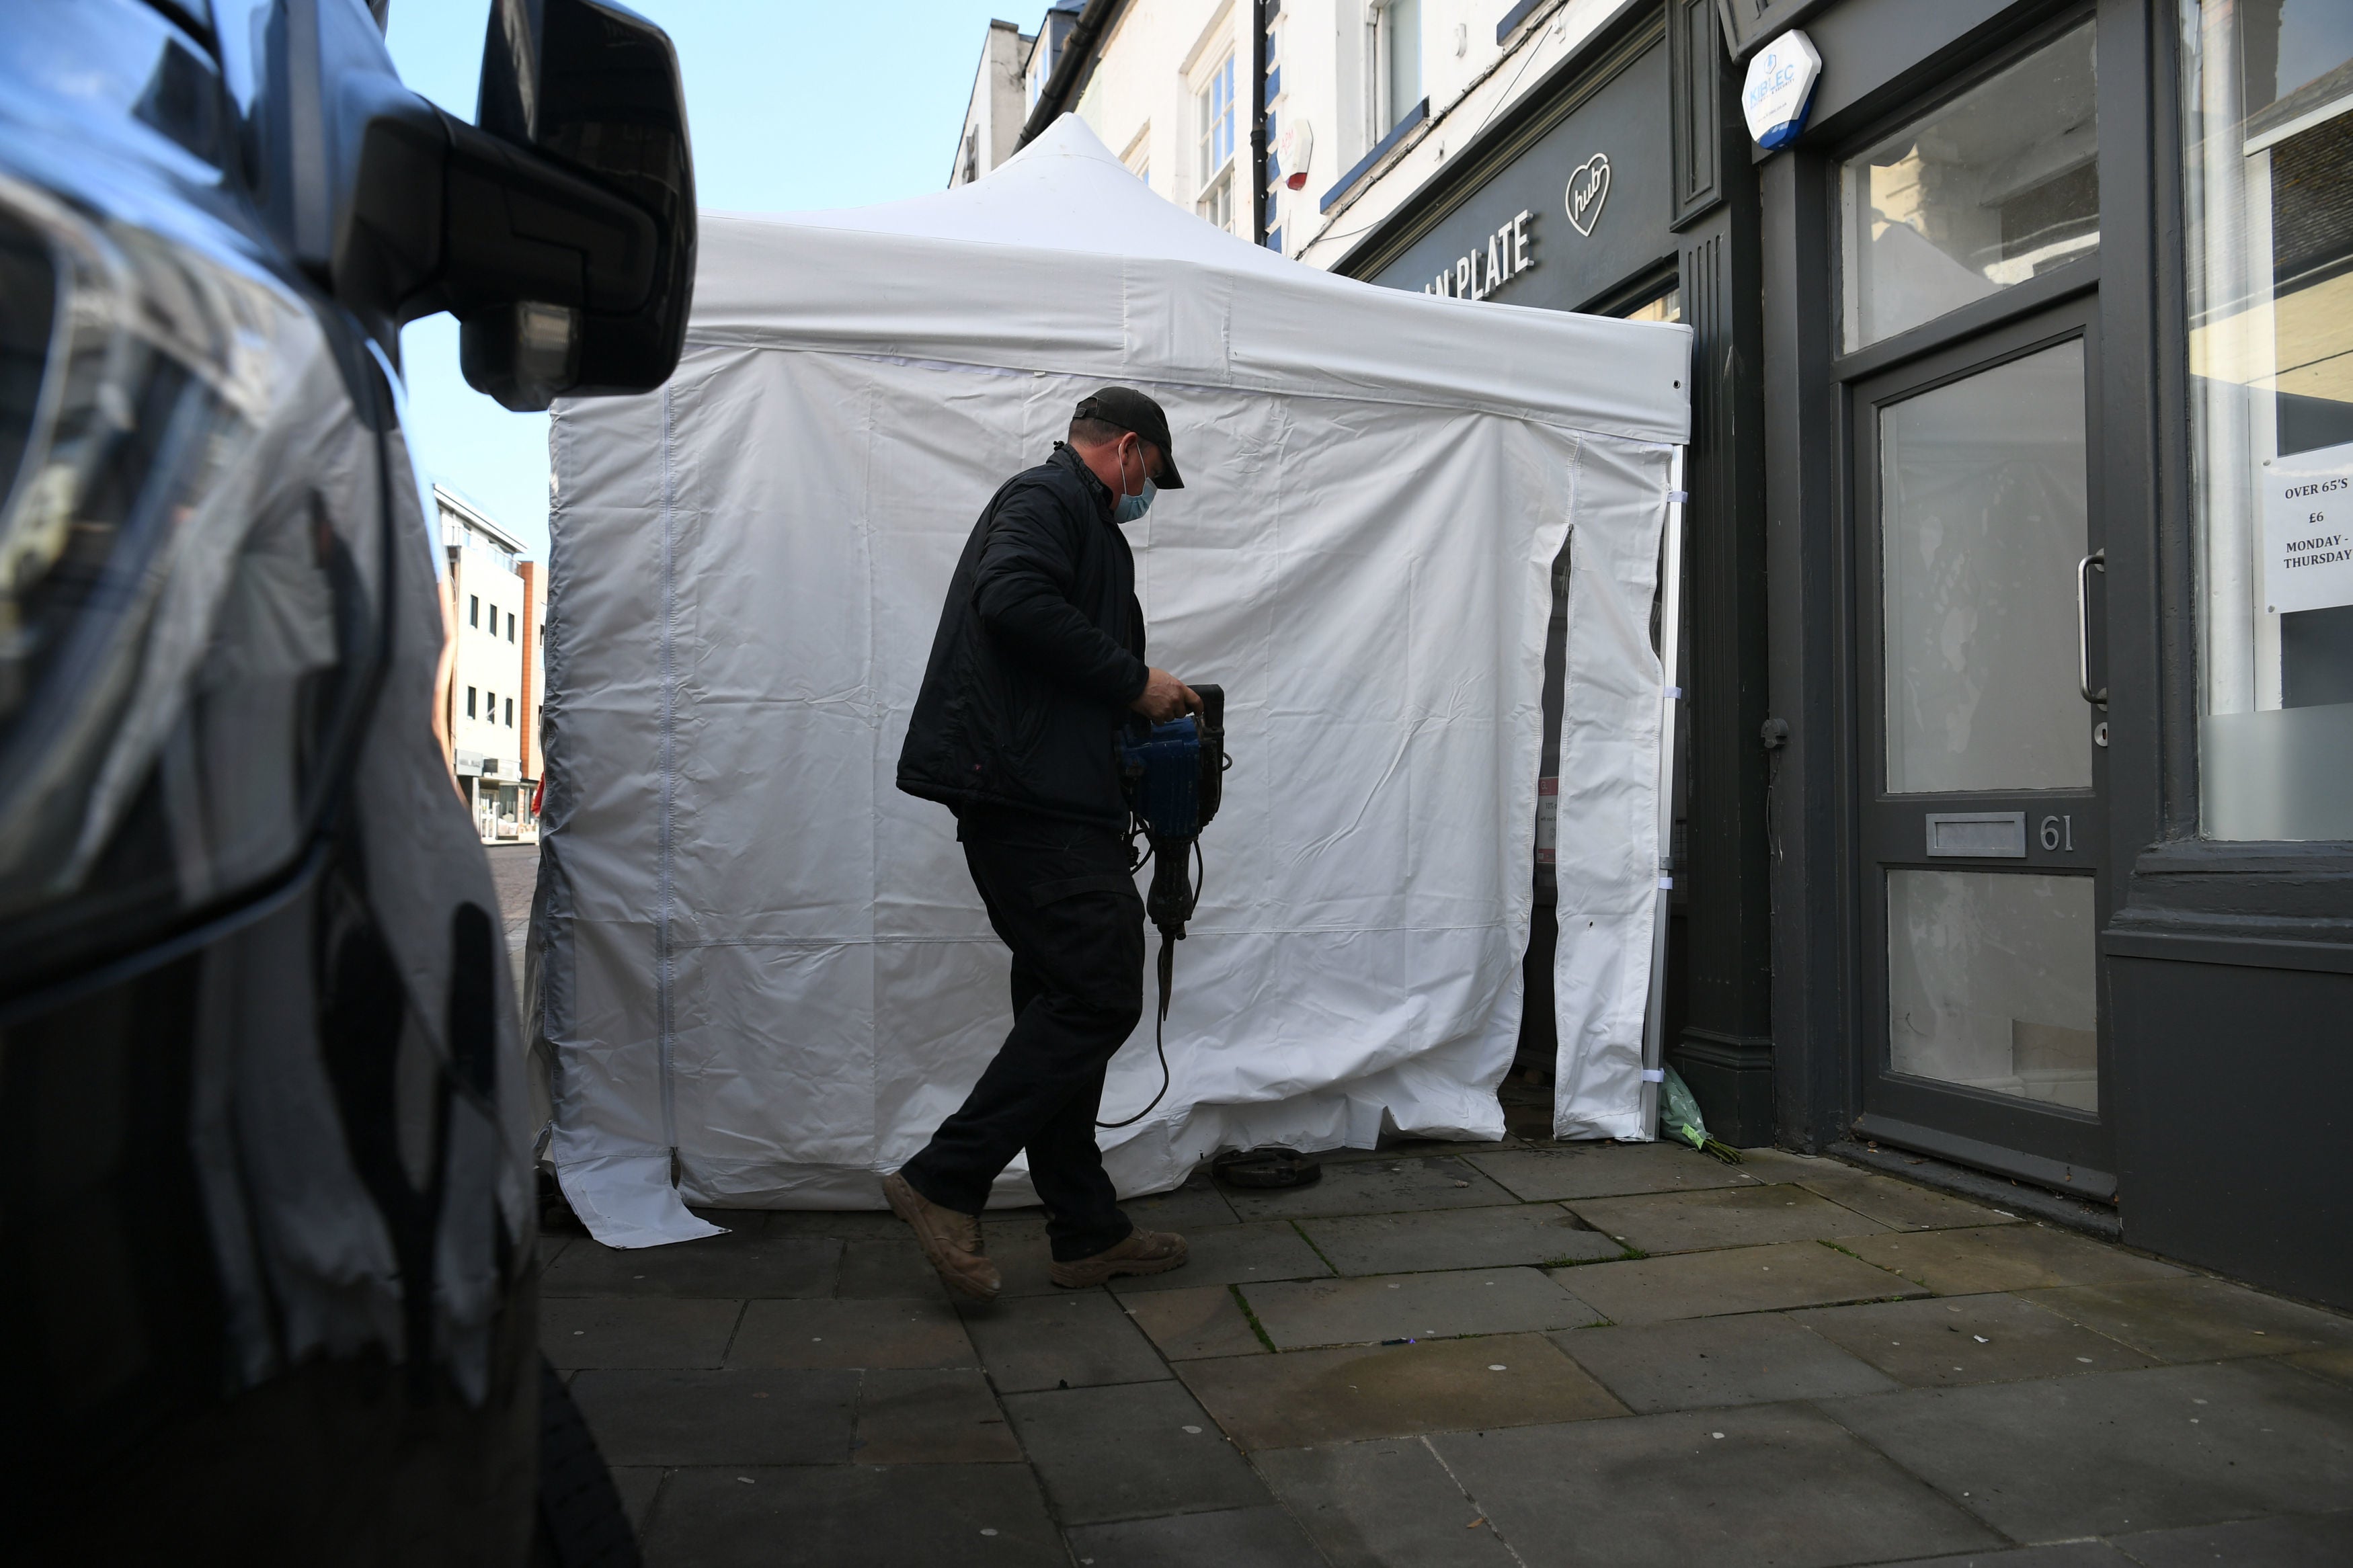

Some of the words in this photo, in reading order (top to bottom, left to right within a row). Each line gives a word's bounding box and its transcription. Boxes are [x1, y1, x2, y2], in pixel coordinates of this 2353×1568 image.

[1574, 167, 1601, 220] hub
[1457, 209, 1529, 300] PLATE
[2285, 484, 2319, 499] OVER
[2309, 511, 2324, 524] £6
[2286, 534, 2342, 552] MONDAY
[2284, 549, 2352, 569] THURSDAY
[2040, 815, 2073, 851] 61
